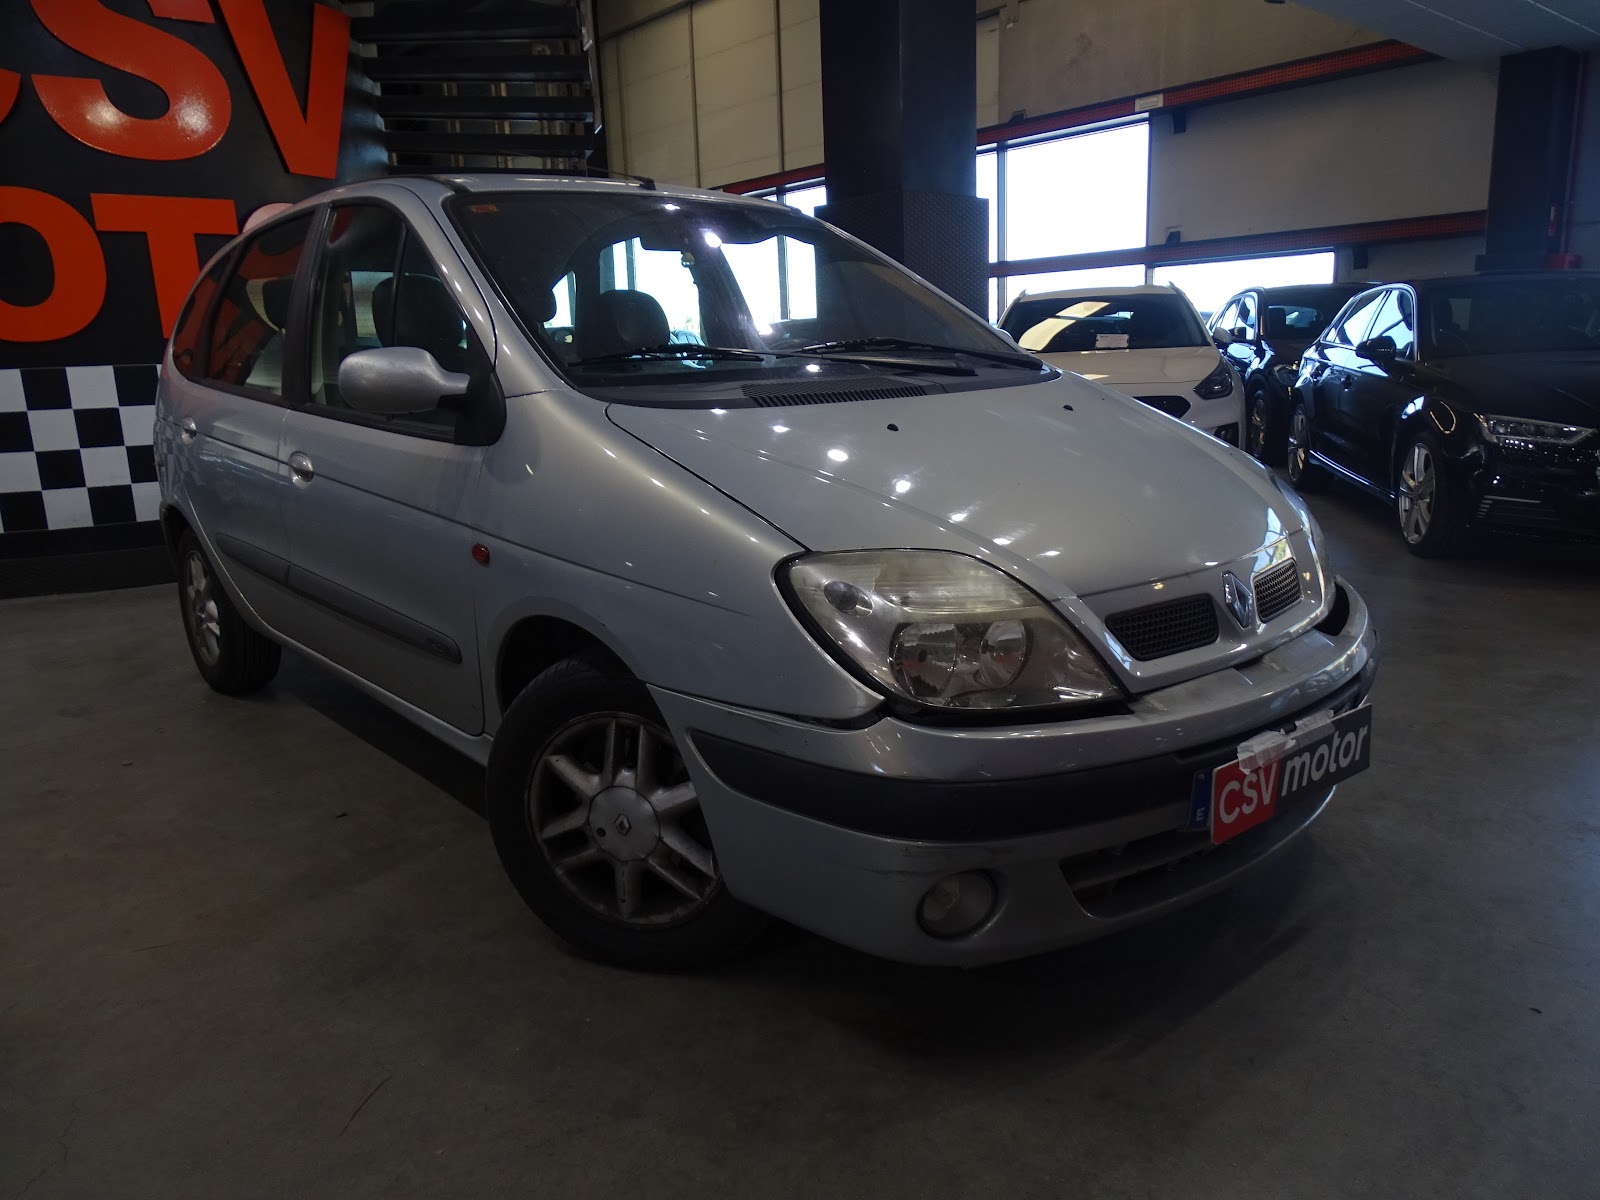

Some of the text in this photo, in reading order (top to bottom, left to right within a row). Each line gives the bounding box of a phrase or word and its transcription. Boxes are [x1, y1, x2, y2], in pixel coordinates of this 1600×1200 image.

[0, 0, 351, 180] SV
[0, 185, 295, 343] OT
[1195, 807, 1206, 822] E
[1219, 724, 1369, 824] CSV motor
